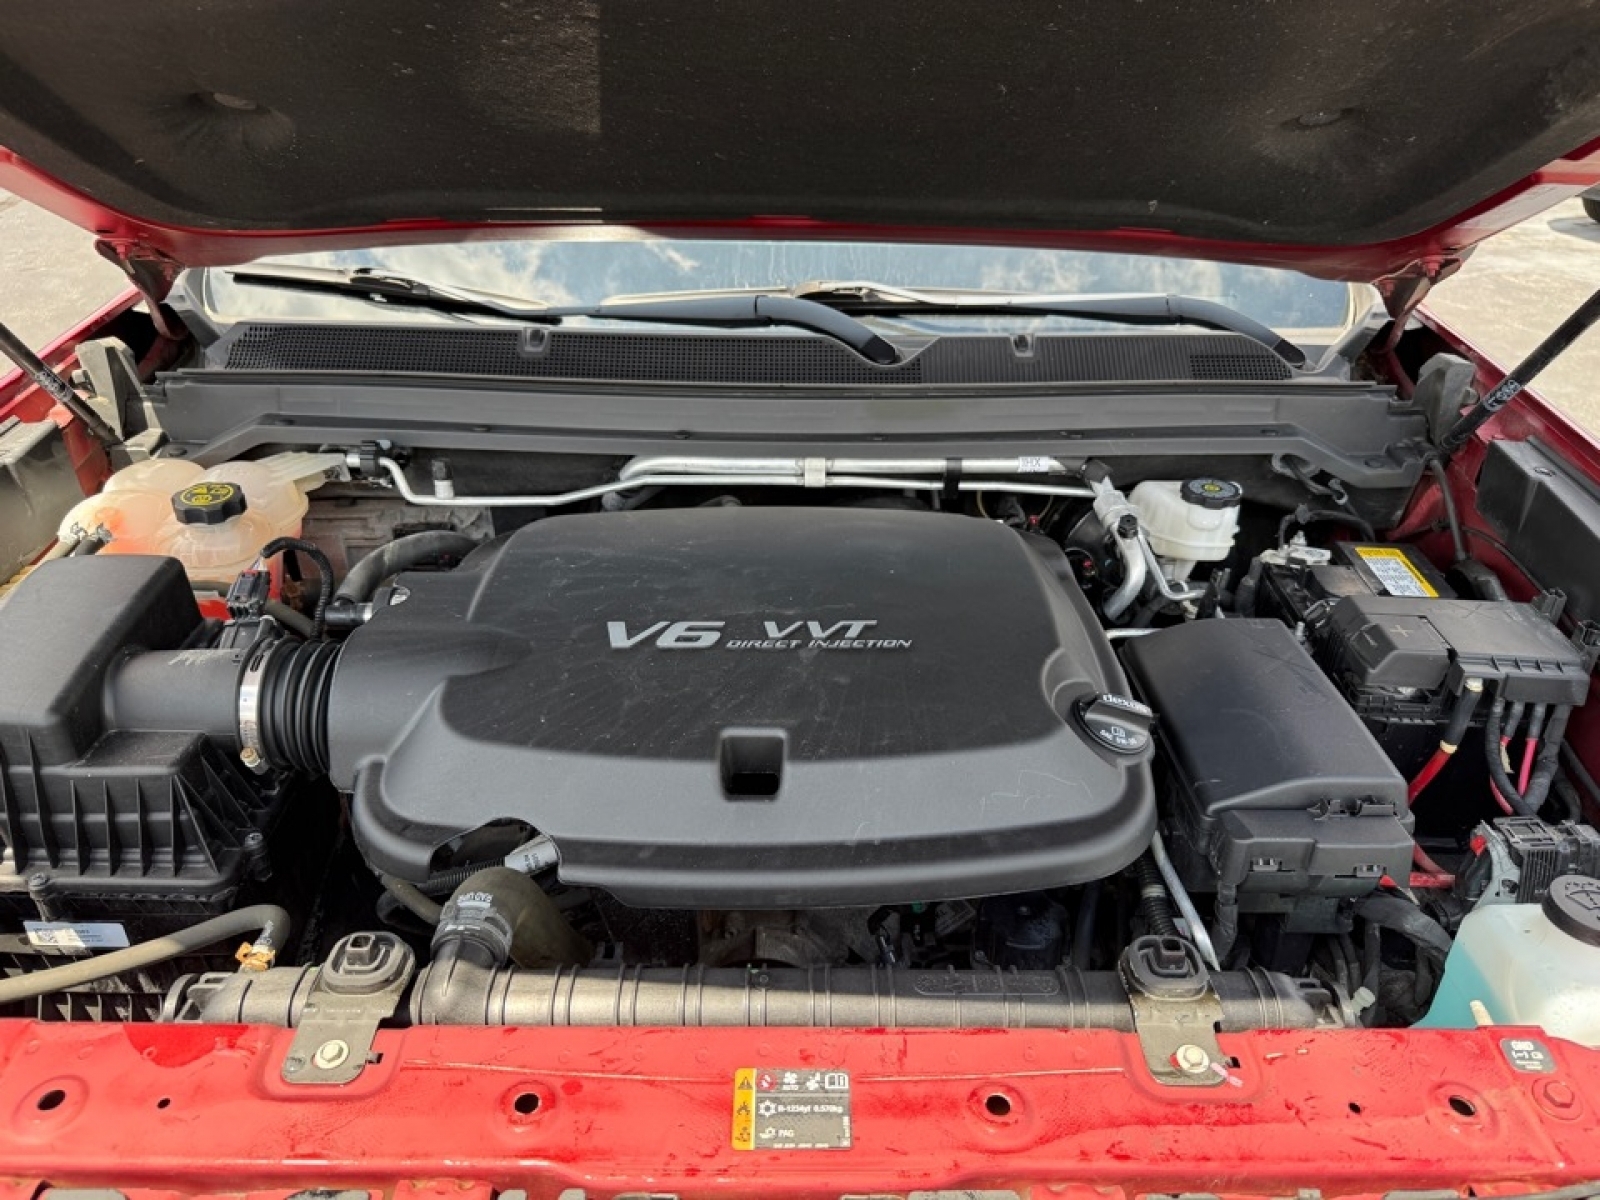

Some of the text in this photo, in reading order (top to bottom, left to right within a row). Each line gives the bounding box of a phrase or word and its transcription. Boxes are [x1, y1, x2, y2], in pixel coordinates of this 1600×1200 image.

[607, 619, 878, 649] V6 VVT
[726, 639, 912, 649] DIRECT INJECTION
